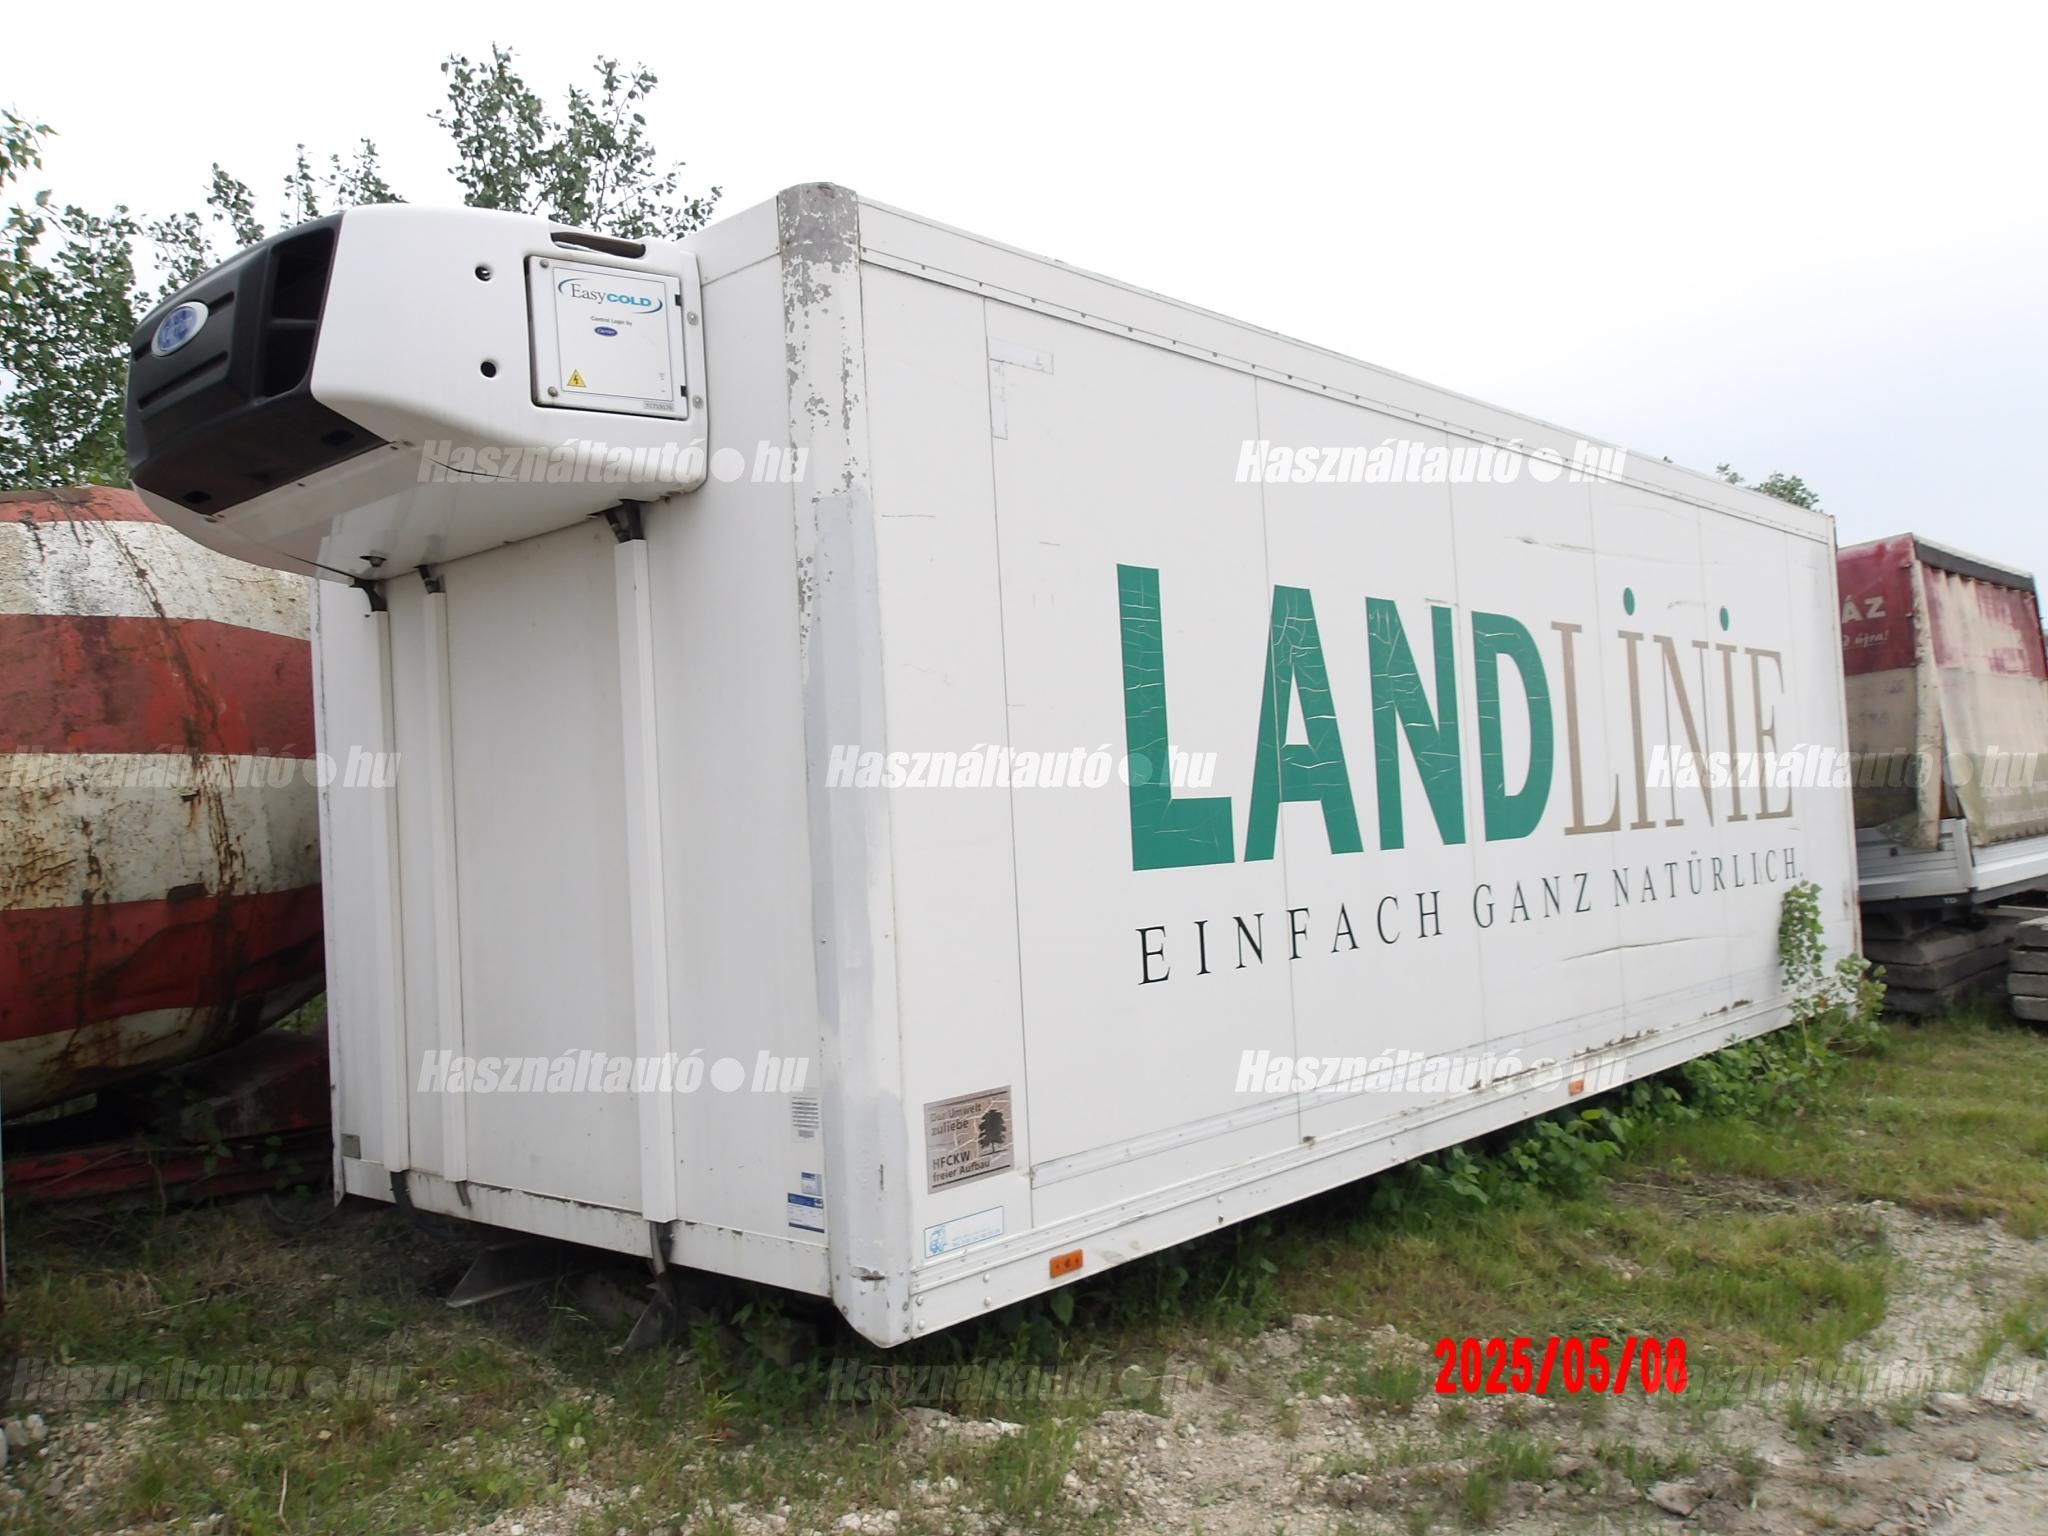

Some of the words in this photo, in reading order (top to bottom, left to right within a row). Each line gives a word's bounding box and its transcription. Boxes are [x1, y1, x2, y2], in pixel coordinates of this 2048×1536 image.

[571, 283, 652, 307] EasyCOLD
[1116, 563, 1794, 872] LANDLINIE
[1136, 890, 1443, 986] EINFACH
[1473, 872, 1592, 929] GANZ
[931, 1119, 969, 1136] zuliebe
[932, 1151, 971, 1170] HFCKW
[933, 1169, 957, 1182] freier
[959, 1160, 991, 1175] Aufbau
